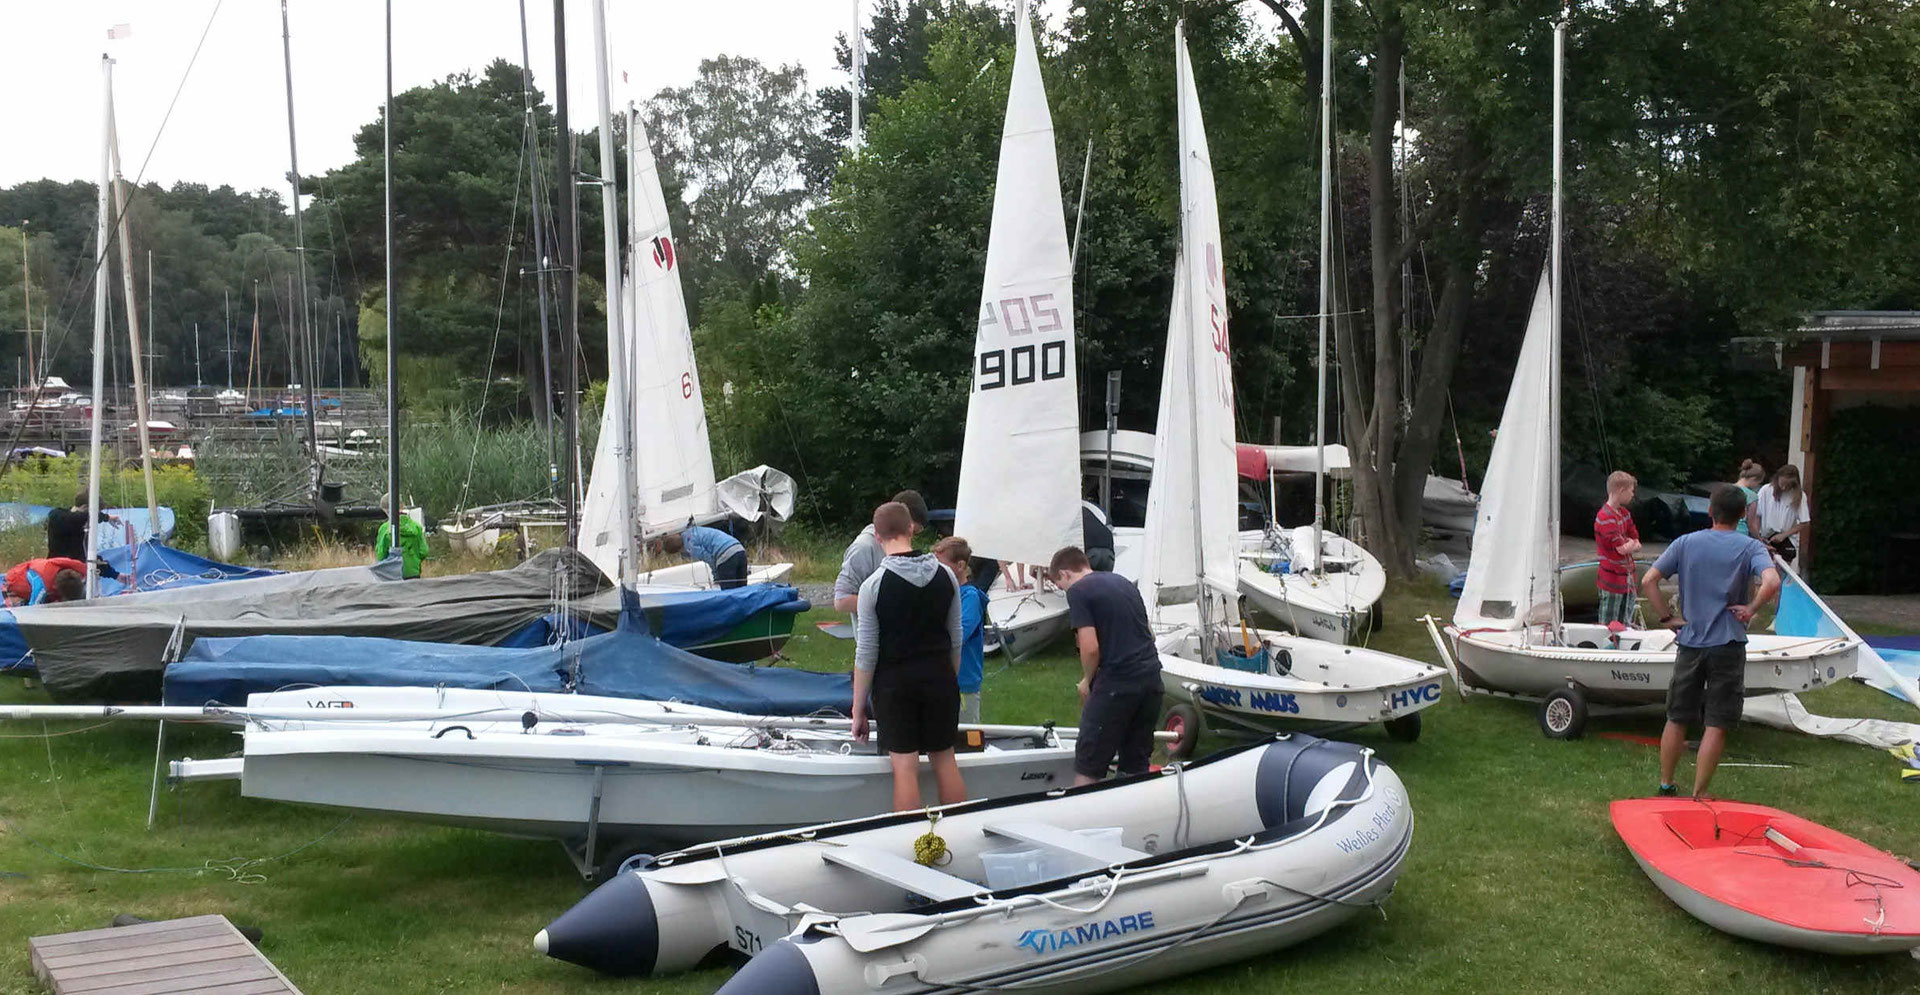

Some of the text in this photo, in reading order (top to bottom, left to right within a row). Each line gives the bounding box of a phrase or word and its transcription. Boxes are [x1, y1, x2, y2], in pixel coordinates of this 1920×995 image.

[1611, 669, 1650, 684] Nessy
[1391, 683, 1442, 709] HYC
[1021, 771, 1048, 781] Laser
[1372, 802, 1396, 832] Pferd
[1018, 910, 1155, 955] VIAMARE
